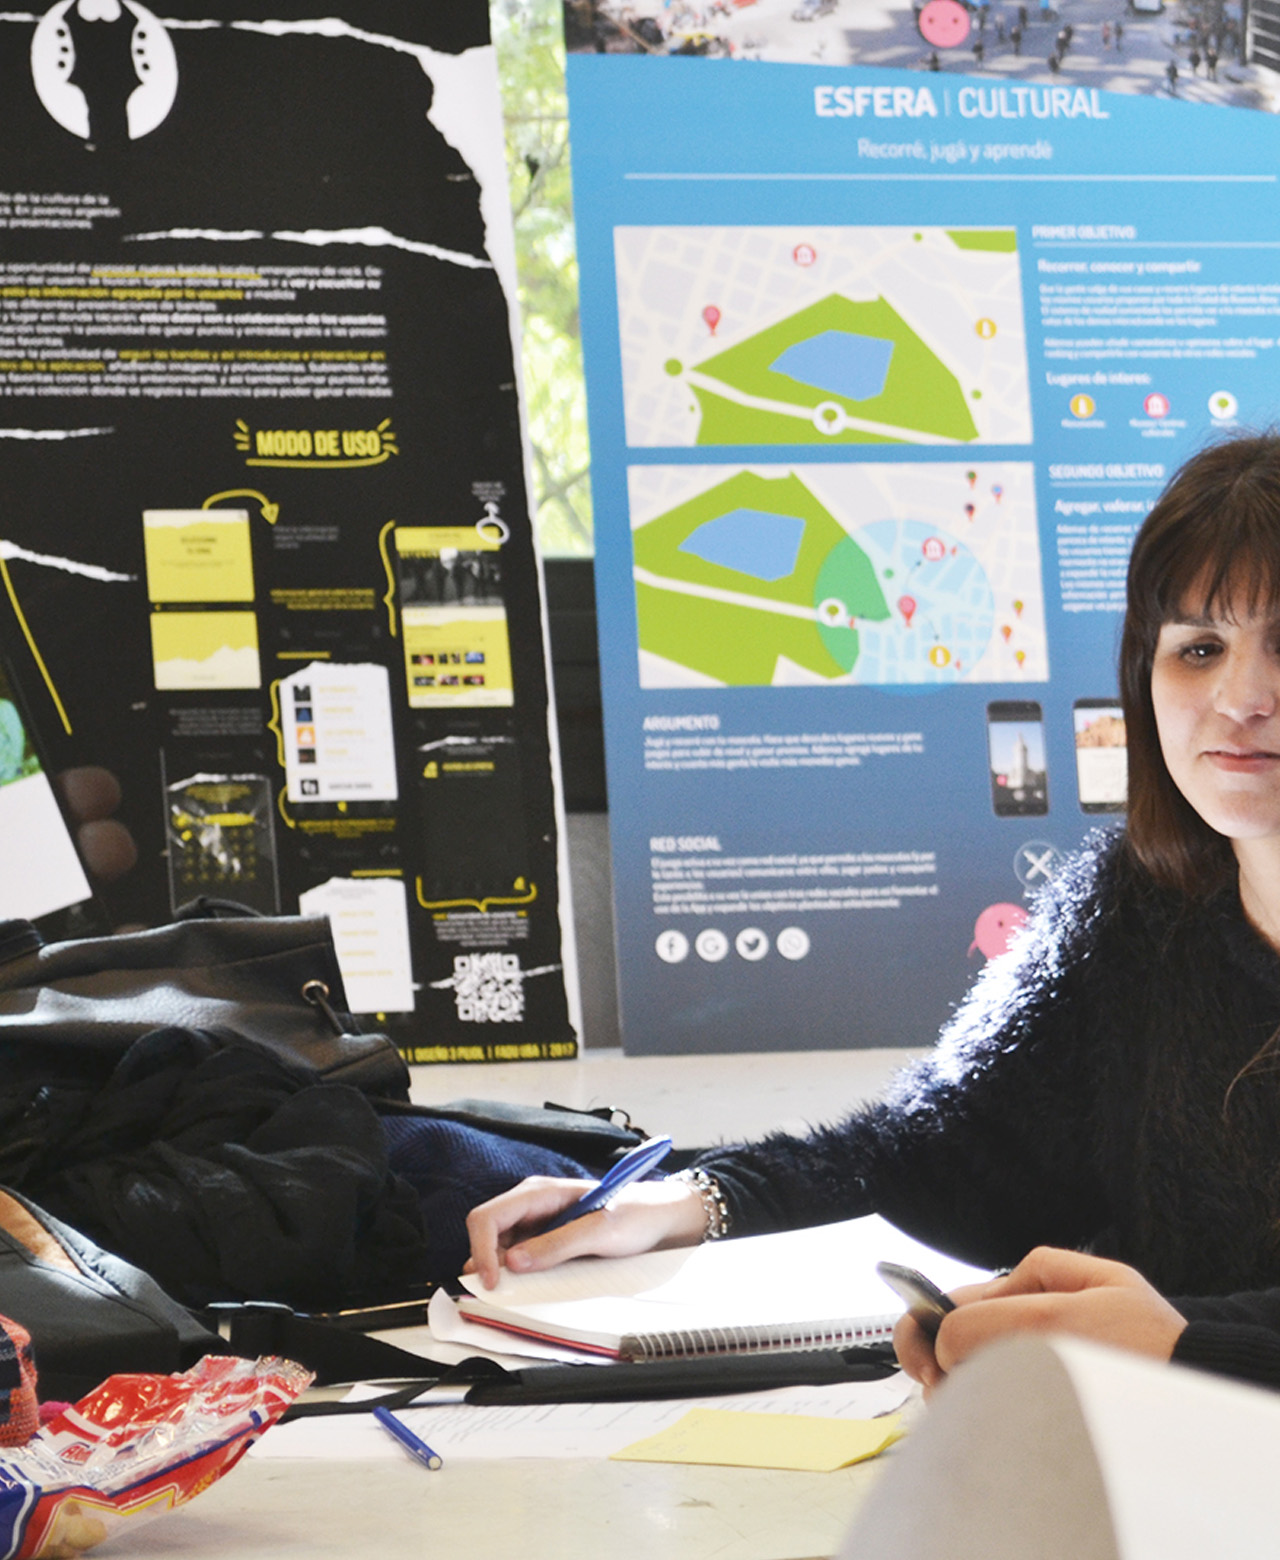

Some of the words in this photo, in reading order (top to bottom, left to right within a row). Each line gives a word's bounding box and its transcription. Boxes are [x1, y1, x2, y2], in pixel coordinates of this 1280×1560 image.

[813, 86, 937, 117] ESFERA
[958, 87, 1110, 119] CULTURAL
[857, 138, 927, 160] Recorré,
[969, 146, 982, 163] y
[983, 139, 1053, 162] aprendé
[1032, 225, 1077, 239] PRIMER
[1078, 225, 1136, 239] OBJETIVO
[1046, 372, 1091, 387] Lugares
[1092, 372, 1107, 385] de
[255, 430, 312, 456] MODO
[313, 430, 340, 456] DE
[341, 430, 381, 456] USO
[1049, 463, 1104, 479] SEGUNDO
[1105, 463, 1164, 479] OBJETIVO
[643, 714, 720, 731] ARGUMENTO
[650, 836, 676, 852] RED
[677, 835, 721, 851] SOCIAL
